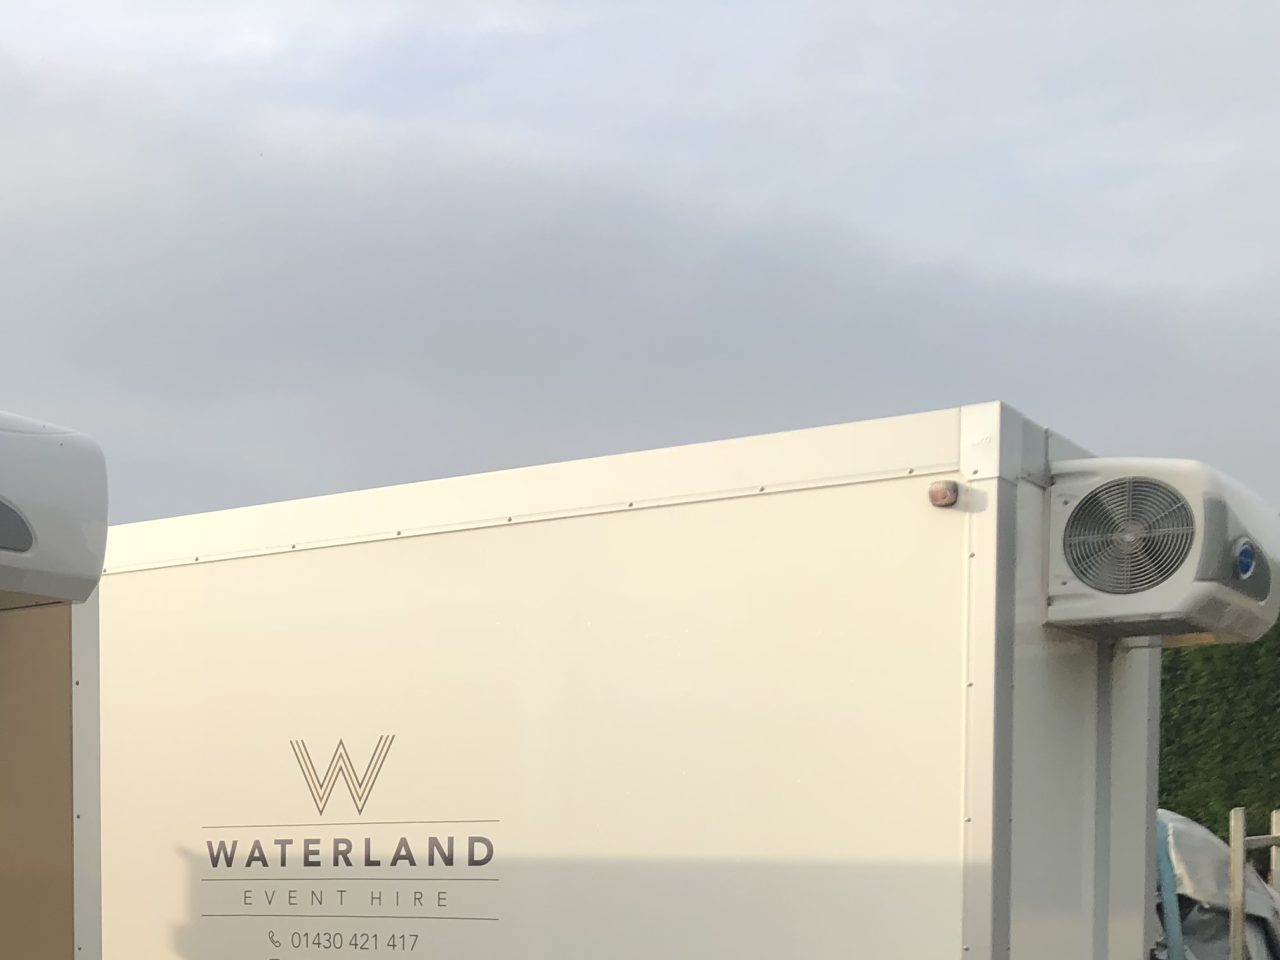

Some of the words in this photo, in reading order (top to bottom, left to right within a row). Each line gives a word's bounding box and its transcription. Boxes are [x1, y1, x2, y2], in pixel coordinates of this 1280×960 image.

[206, 836, 495, 868] WATERLAND
[243, 889, 348, 906] EVENT
[370, 891, 448, 907] HIRE
[290, 932, 344, 950] 01430
[348, 933, 379, 951] 421
[386, 934, 419, 951] 417
